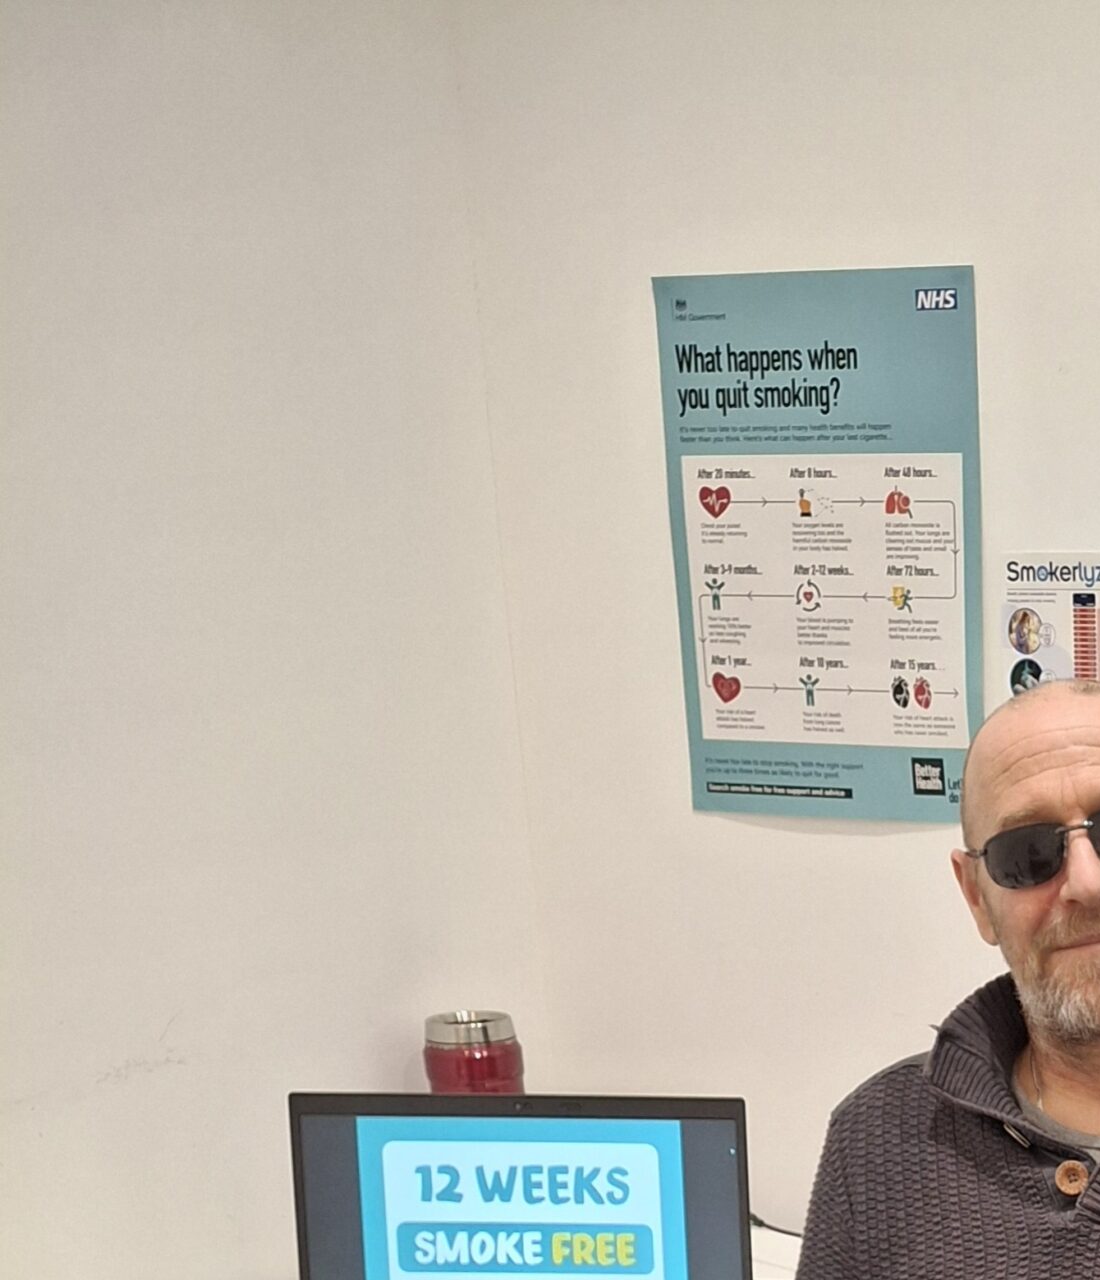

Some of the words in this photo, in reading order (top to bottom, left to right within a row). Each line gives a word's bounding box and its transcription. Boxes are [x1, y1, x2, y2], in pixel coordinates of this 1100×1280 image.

[916, 289, 957, 310] NHS
[675, 344, 723, 373] What
[727, 342, 802, 380] happens
[807, 340, 858, 371] when
[678, 387, 710, 417] you
[715, 380, 750, 416] quit
[754, 377, 840, 416] smoking?
[914, 763, 941, 778] Better
[915, 777, 943, 790] Health
[415, 1164, 464, 1203] 12
[475, 1165, 630, 1206] WEEKS
[415, 1230, 545, 1266] SMOKE
[551, 1231, 638, 1268] FREE
